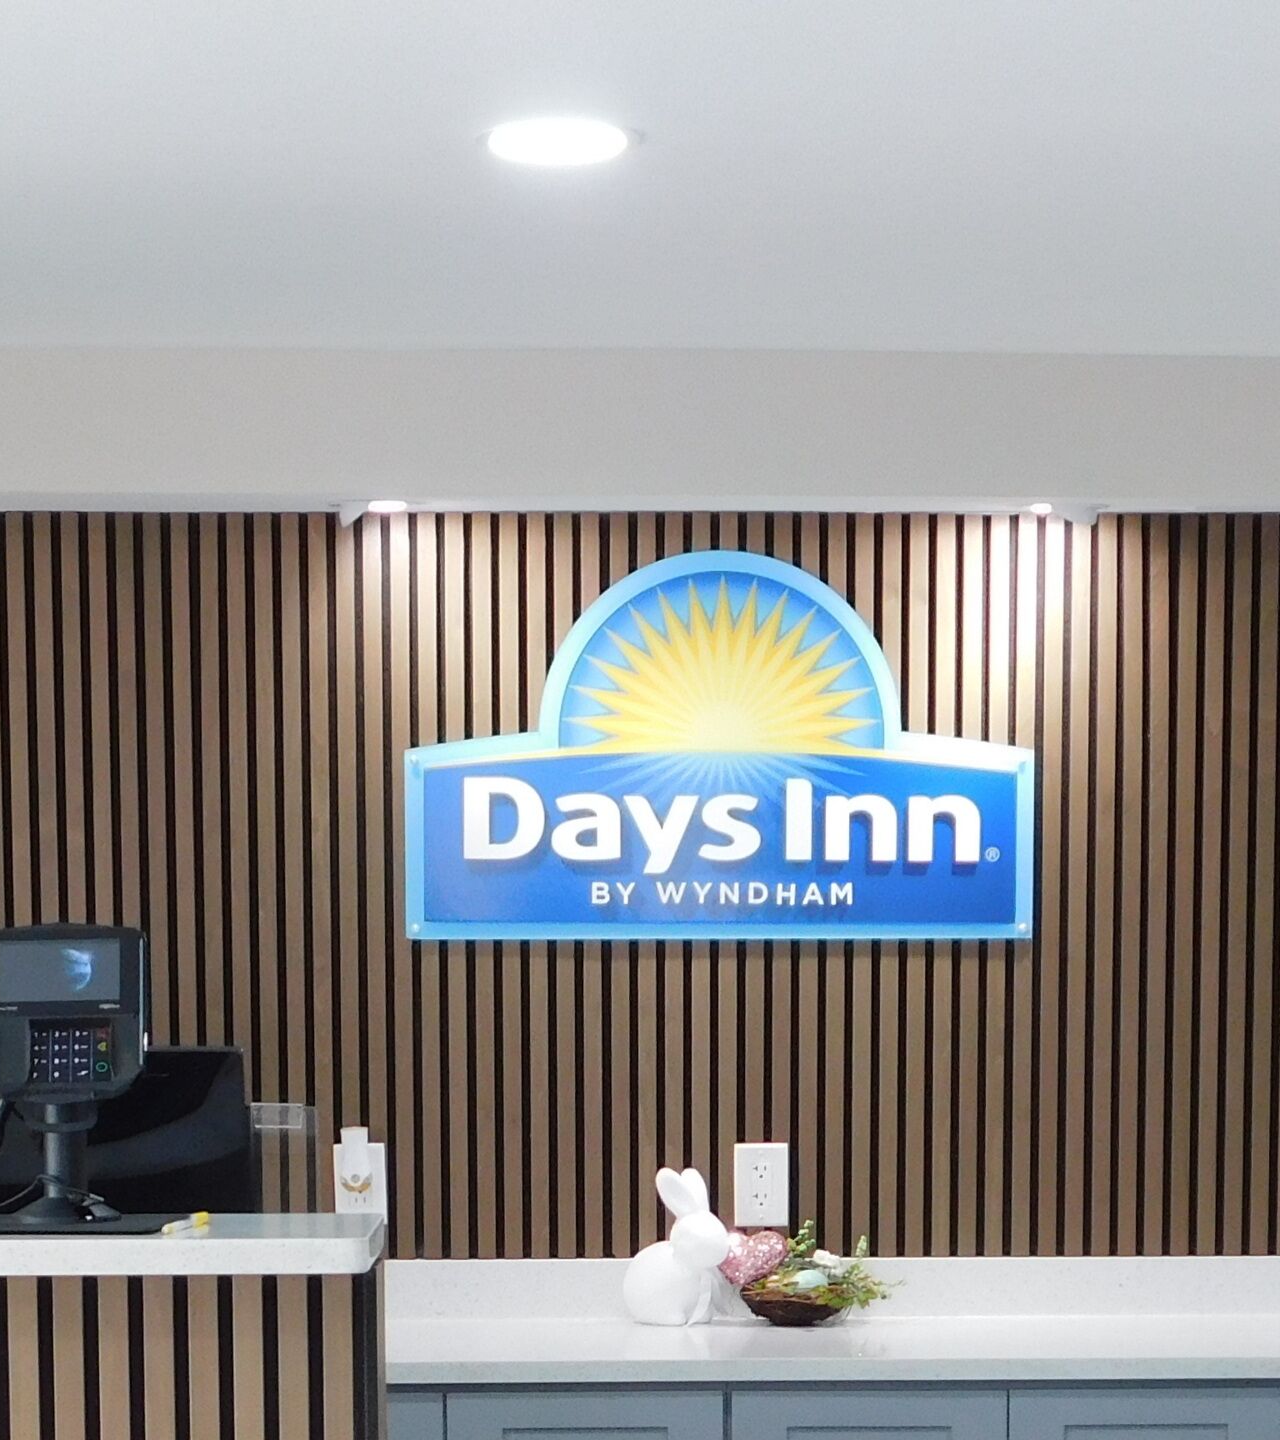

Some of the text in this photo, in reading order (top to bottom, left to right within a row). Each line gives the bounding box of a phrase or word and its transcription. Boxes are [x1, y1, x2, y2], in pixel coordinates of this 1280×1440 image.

[463, 776, 981, 875] Days Inn
[591, 882, 854, 905] BY WYNDHAM
